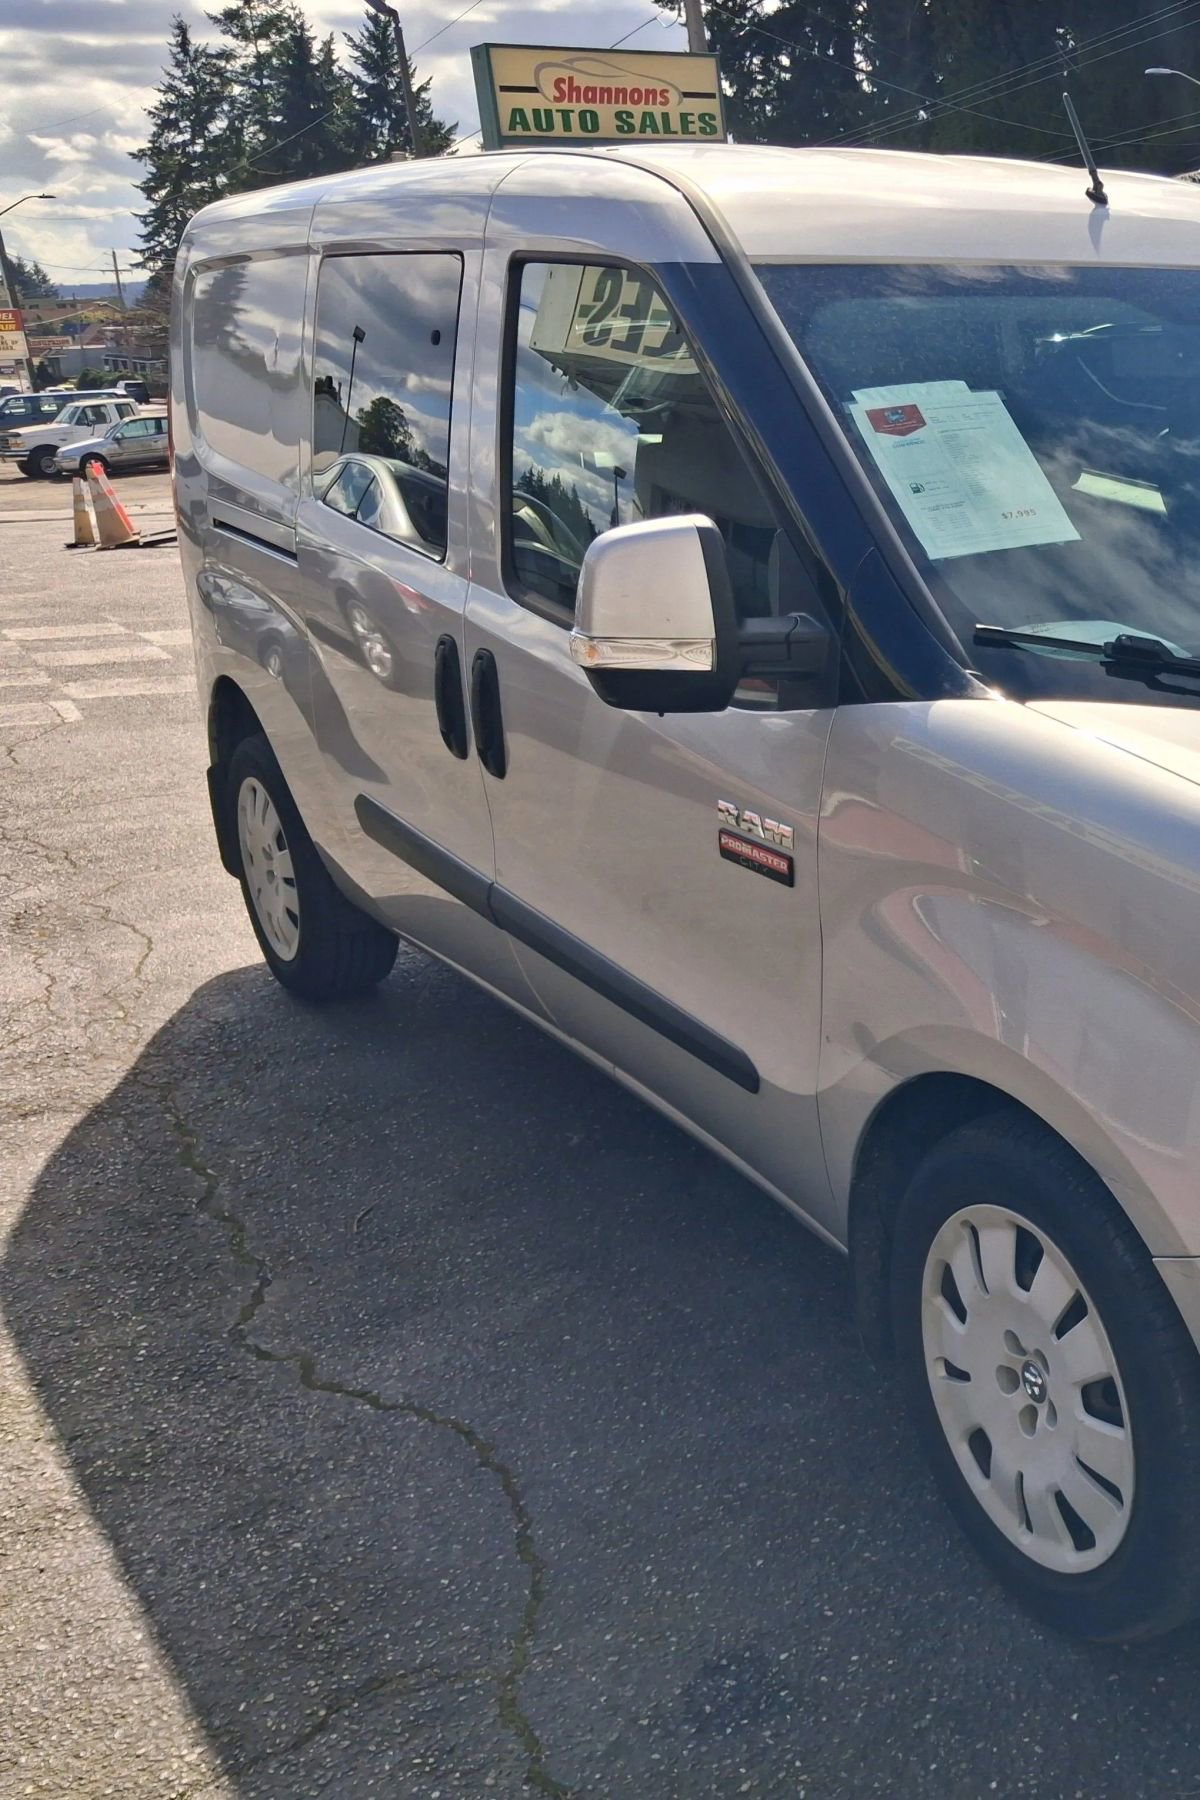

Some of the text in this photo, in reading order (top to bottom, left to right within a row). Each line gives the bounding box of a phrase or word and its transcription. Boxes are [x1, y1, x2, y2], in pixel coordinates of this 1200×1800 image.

[553, 76, 670, 106] Shannons
[508, 107, 718, 136] AUTO SALES
[718, 799, 794, 850] RAM
